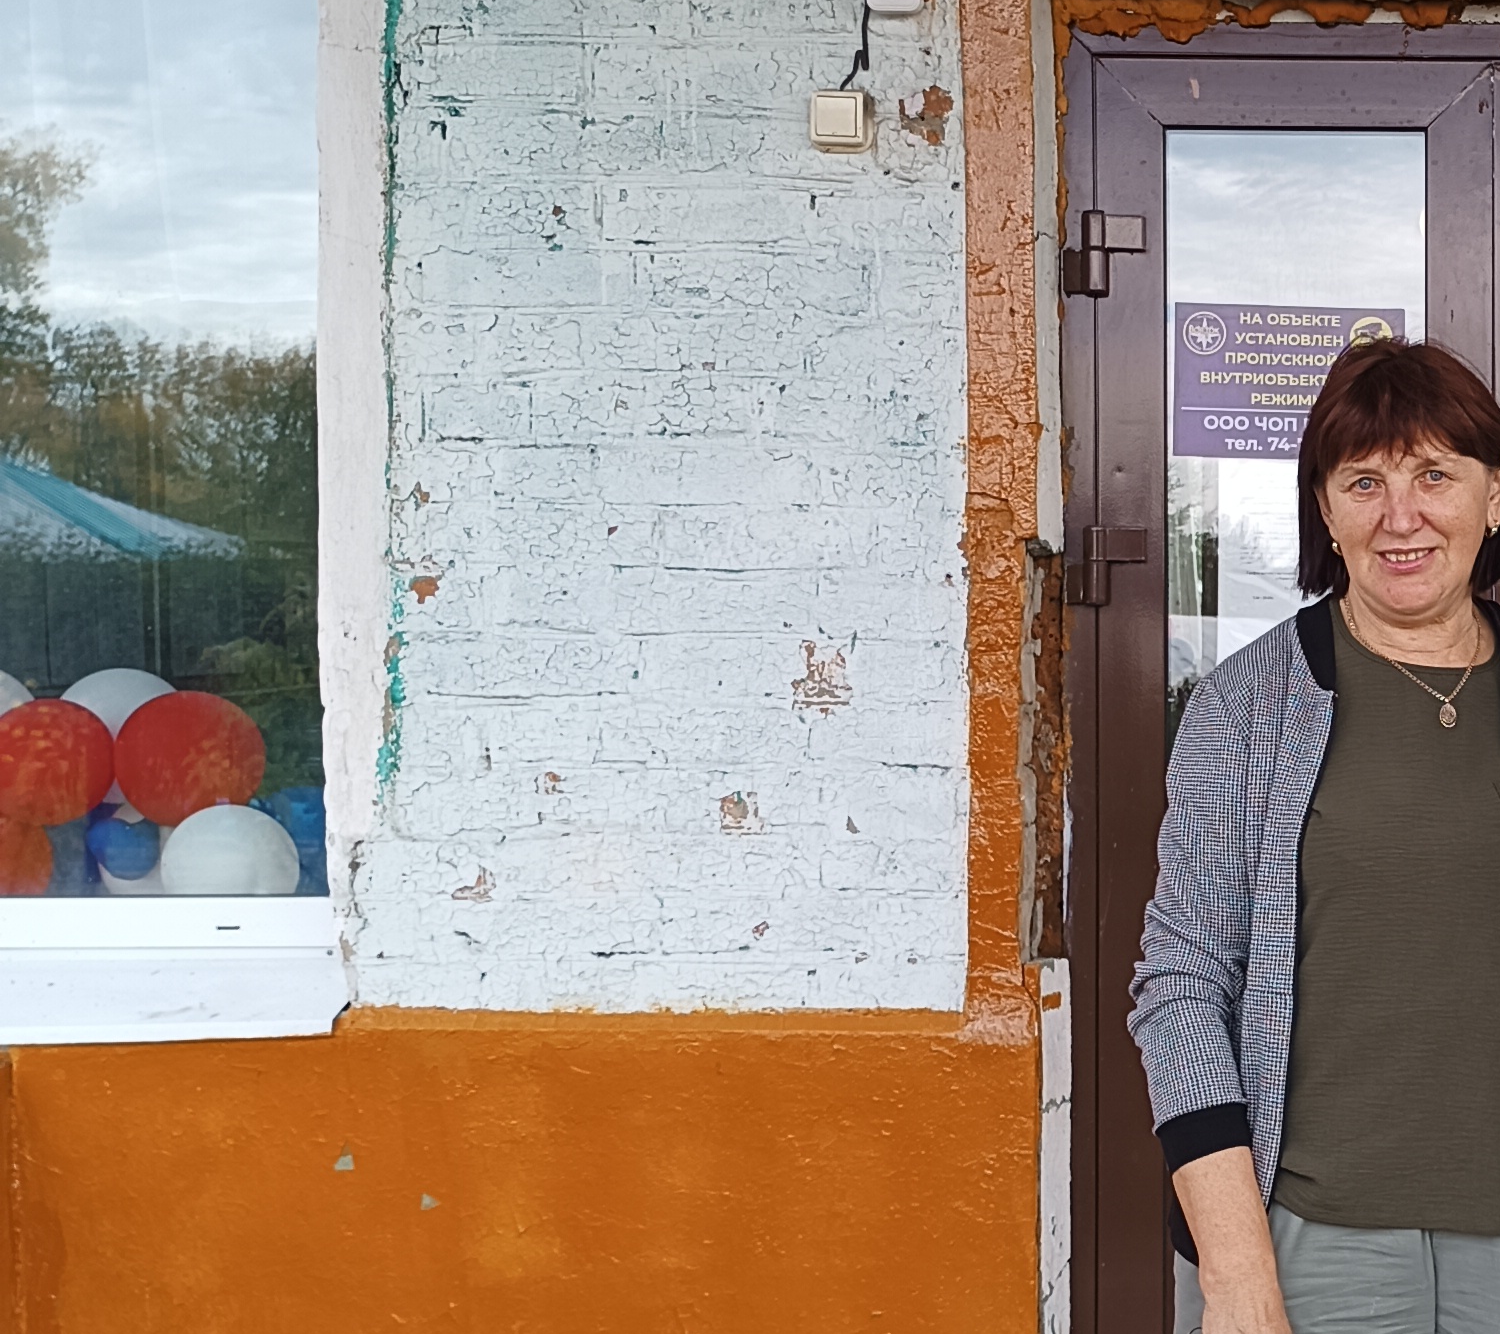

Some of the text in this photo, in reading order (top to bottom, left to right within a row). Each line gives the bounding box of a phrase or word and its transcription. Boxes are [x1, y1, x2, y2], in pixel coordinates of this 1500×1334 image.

[1240, 312, 1340, 326] НА ОБЪЕКТЕ
[1235, 332, 1343, 347] УСТАНОВЛЕН
[1225, 352, 1337, 366] ПРОПУСКНОЙ
[1201, 372, 1327, 386] ВНУТРИОБЪЕКТ
[1204, 415, 1249, 430] ООО
[1255, 417, 1297, 431] ЧОП
[1225, 437, 1302, 451] тел. 74-
